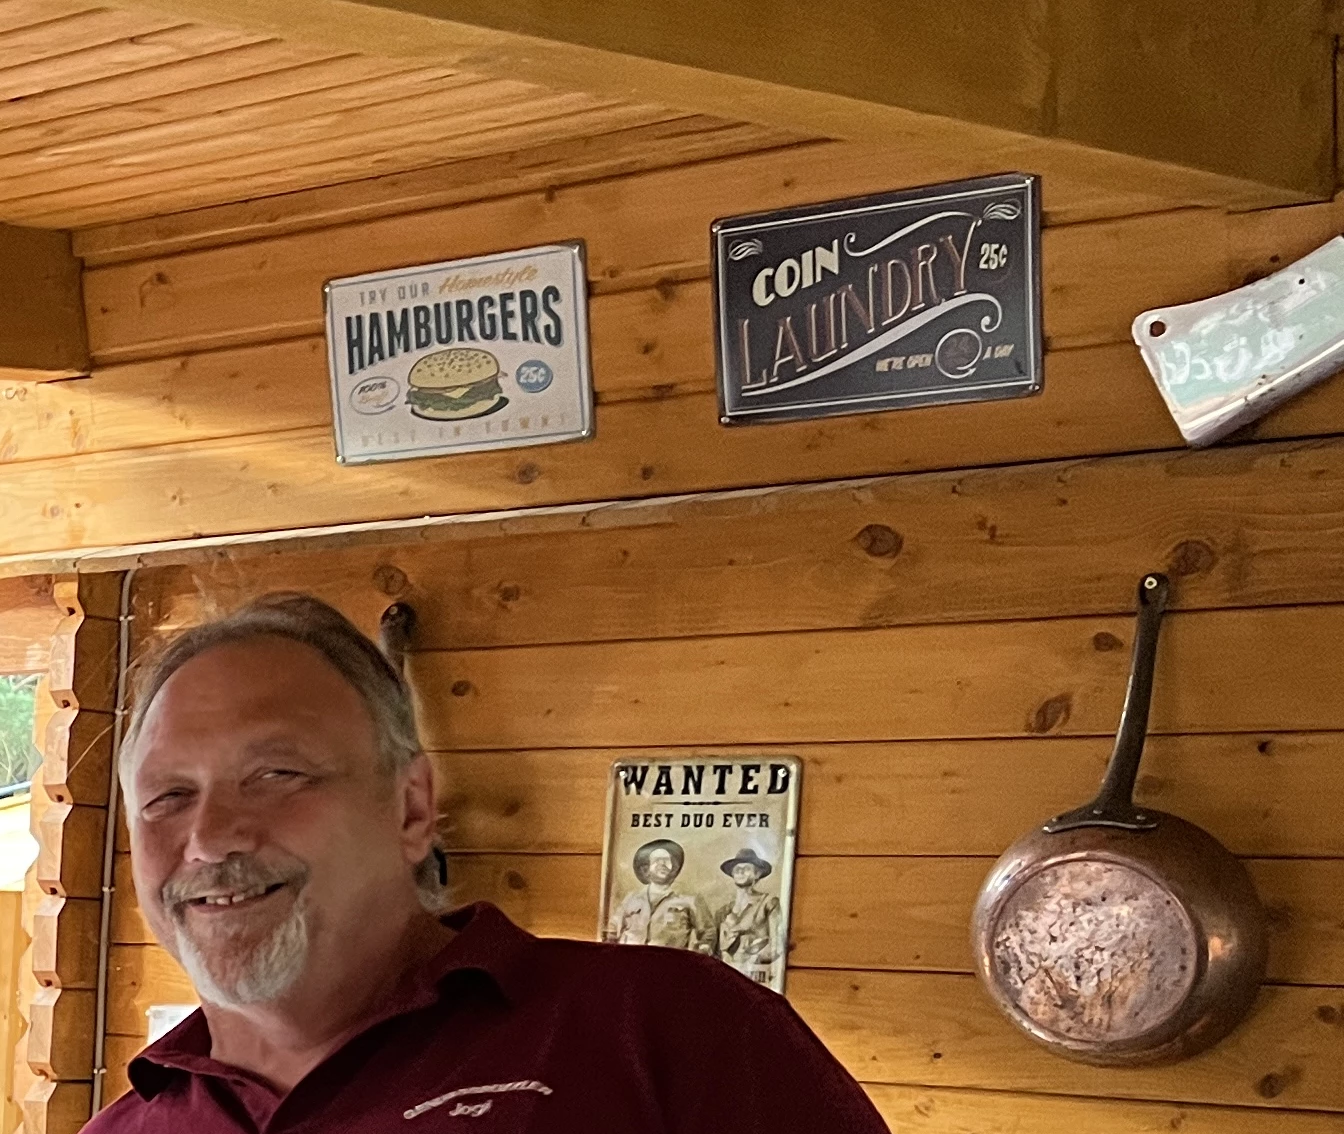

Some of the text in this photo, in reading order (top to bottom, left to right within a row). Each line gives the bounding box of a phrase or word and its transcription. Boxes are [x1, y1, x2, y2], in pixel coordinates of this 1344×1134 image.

[752, 238, 841, 307] COIN
[979, 243, 1008, 270] 25¢
[359, 265, 539, 307] TRY OUR Homestyle
[738, 219, 982, 391] LAUNDRY
[345, 285, 563, 375] HAMBURGERS
[618, 764, 791, 796] WANTED
[630, 813, 771, 829] BEST DUO EVER
